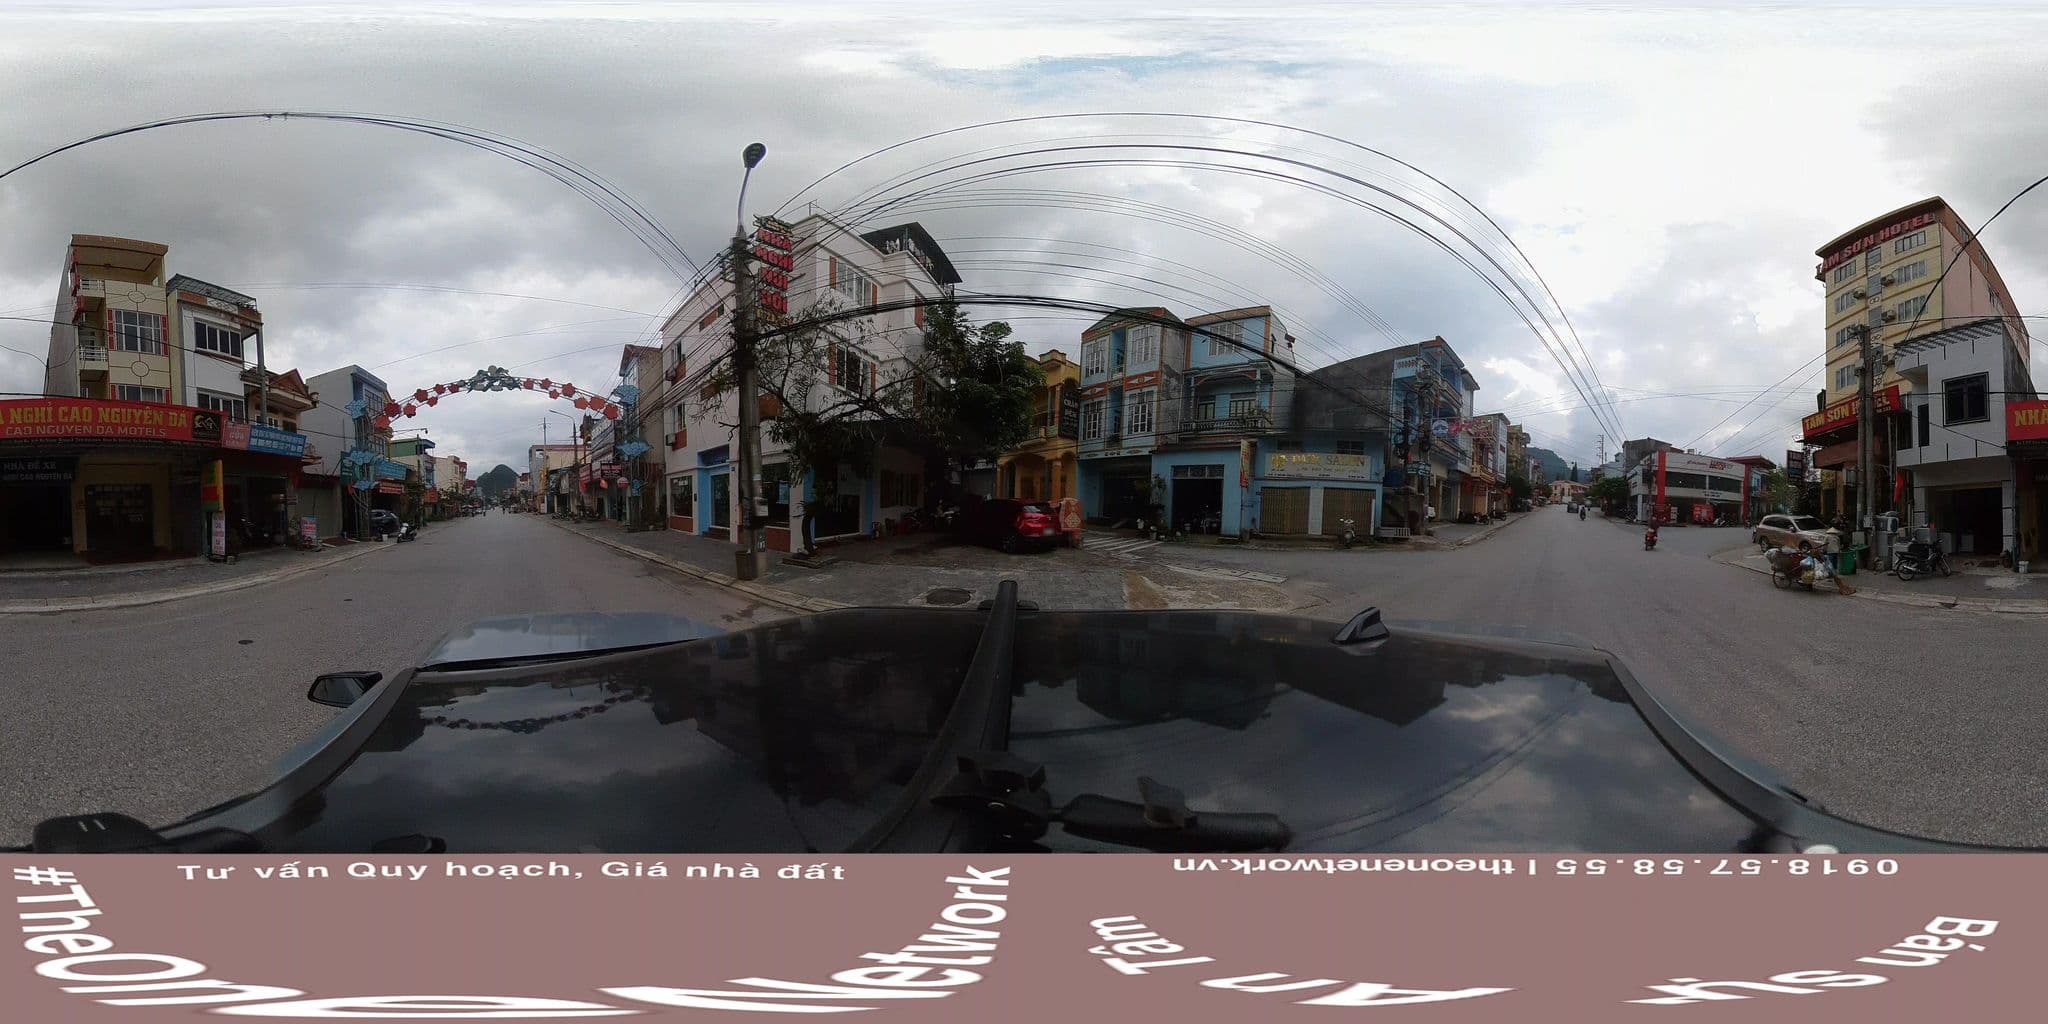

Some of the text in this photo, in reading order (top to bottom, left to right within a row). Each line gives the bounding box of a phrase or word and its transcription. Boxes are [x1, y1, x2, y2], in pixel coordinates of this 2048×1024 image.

[58, 406, 93, 423] CAO
[97, 405, 163, 426] NGUYÊN
[118, 426, 168, 438] MOTELS
